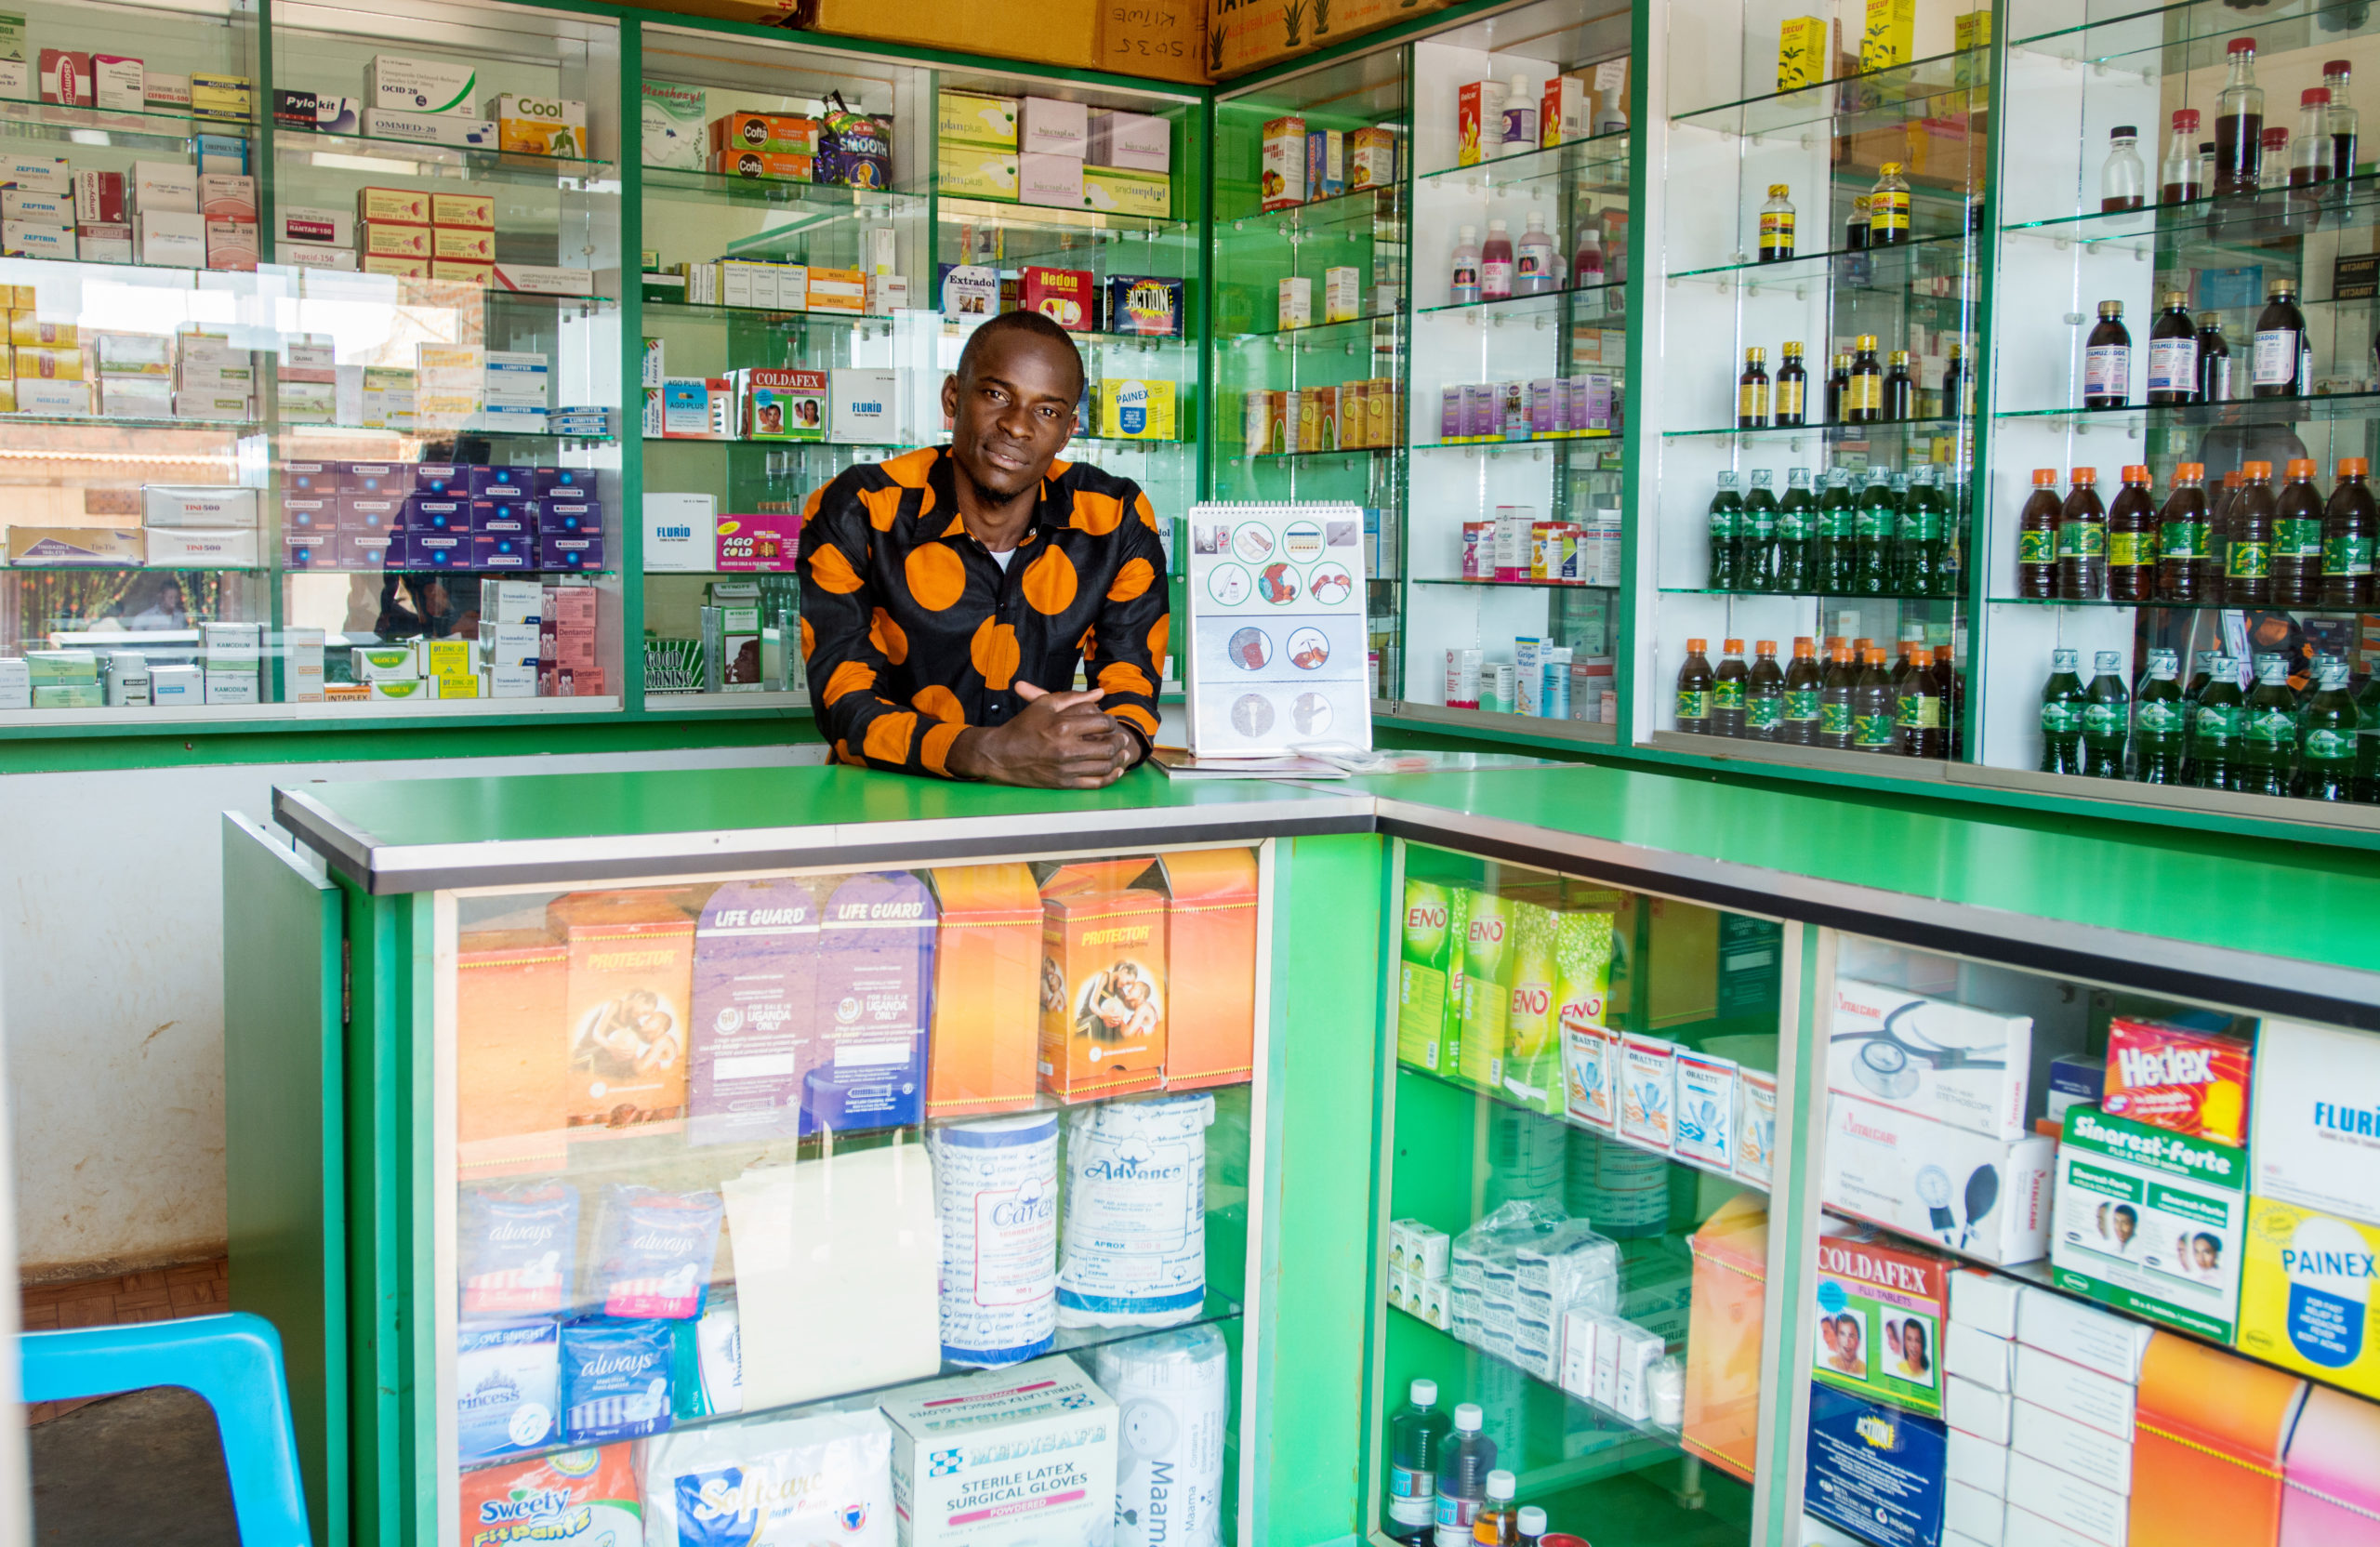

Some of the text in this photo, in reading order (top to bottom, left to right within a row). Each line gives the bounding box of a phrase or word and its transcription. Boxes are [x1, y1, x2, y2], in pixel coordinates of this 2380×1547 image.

[382, 85, 406, 94] OCID
[286, 97, 336, 111] Pylo kit
[518, 99, 562, 118] Cool
[376, 120, 437, 134] OMMED-20
[840, 139, 888, 157] SMOOTH
[16, 165, 50, 175] ZEPTRIN
[21, 202, 56, 211] ZEPTRIN
[23, 233, 58, 243] ZEPTRIN
[949, 275, 996, 288] Extradol
[1040, 271, 1078, 288] Hedon
[1130, 288, 1169, 312] ACTION
[756, 372, 819, 388] COLDAFEX
[1116, 389, 1151, 404] PAINEX
[722, 537, 754, 547] AGO
[722, 548, 753, 558] COLD
[559, 628, 593, 637] Dentamol
[645, 651, 681, 668] GOOD
[1517, 651, 1536, 661] Gripe
[1517, 659, 1536, 668] Water
[575, 669, 602, 678] Dentamol
[646, 670, 692, 687] ORNING
[327, 694, 368, 702] INTAPLEX
[715, 907, 806, 927] LIFE GUARD
[839, 903, 923, 919] LIFE GUARD
[1408, 908, 1447, 929] ENO
[1081, 926, 1150, 946] PROTECTOR
[1469, 920, 1503, 942] ENO
[588, 950, 677, 969] PROTECTOR
[866, 1000, 908, 1012] UGANDA
[1513, 989, 1549, 1015] ENO
[1562, 998, 1602, 1019] ENO
[747, 1011, 791, 1022] UGANDA
[875, 1011, 898, 1021] ONLY
[756, 1022, 780, 1031] ONLY
[1571, 1033, 1602, 1050] ORALYTE
[1629, 1051, 1665, 1068] ORALYTE
[2119, 1046, 2216, 1088] Hedex
[1686, 1069, 1719, 1085] ORALYTE
[1085, 1160, 1181, 1181] Advance
[489, 1221, 555, 1246] always
[633, 1231, 695, 1256] always
[1094, 1240, 1126, 1250] APROX
[1818, 1246, 1927, 1295] COLDAFEX
[2281, 1250, 2379, 1278] PAINEX
[1859, 1287, 1912, 1308] FLU TABLETS
[480, 1329, 545, 1344] OVERNIGHT
[581, 1353, 653, 1378] always
[970, 1424, 1106, 1466] MEDISAFE
[961, 1461, 1075, 1494] STERILE LATEX
[946, 1473, 1088, 1512] SURGICAL GLOVES
[479, 1488, 569, 1526] Sweety
[990, 1499, 1047, 1517] POWDERED
[1185, 1486, 1197, 1532] Maama
